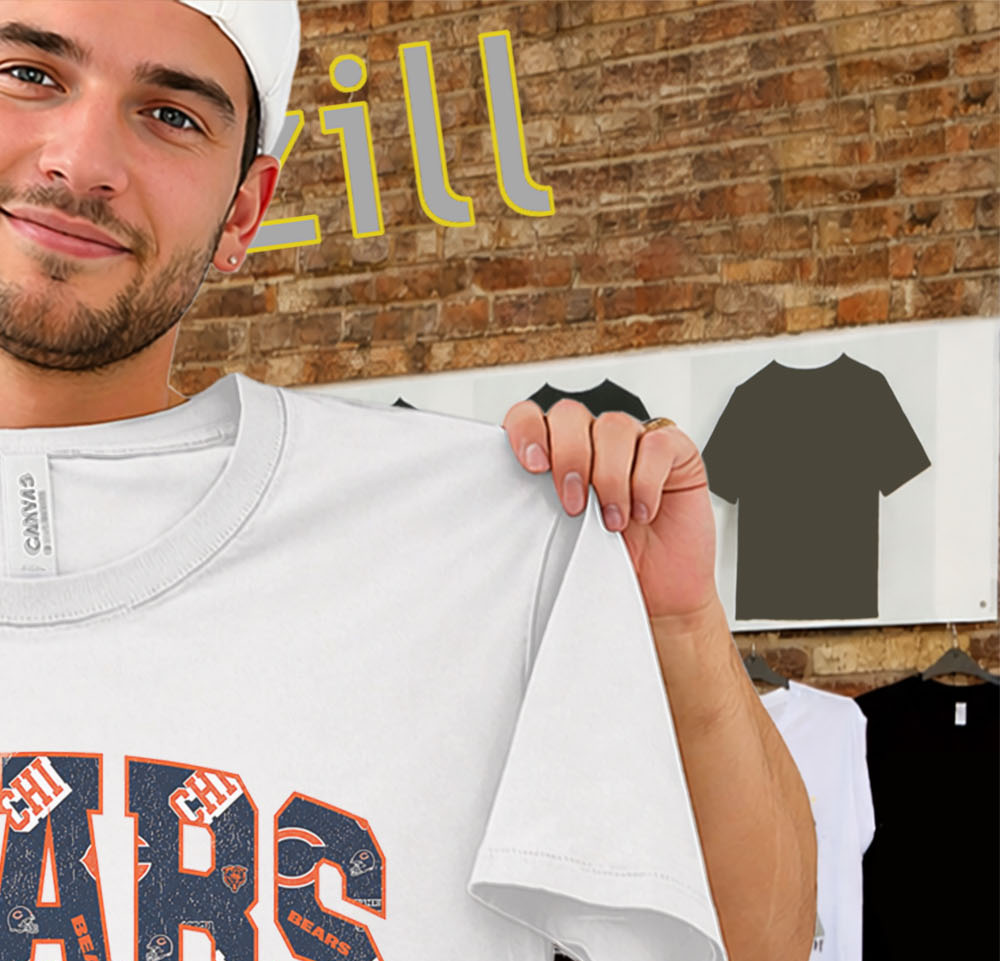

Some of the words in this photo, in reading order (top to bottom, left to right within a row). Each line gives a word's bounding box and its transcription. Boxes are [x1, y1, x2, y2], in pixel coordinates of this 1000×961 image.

[0, 757, 64, 831] CHI
[169, 769, 238, 823] CHI
[284, 905, 352, 960] BEARS
